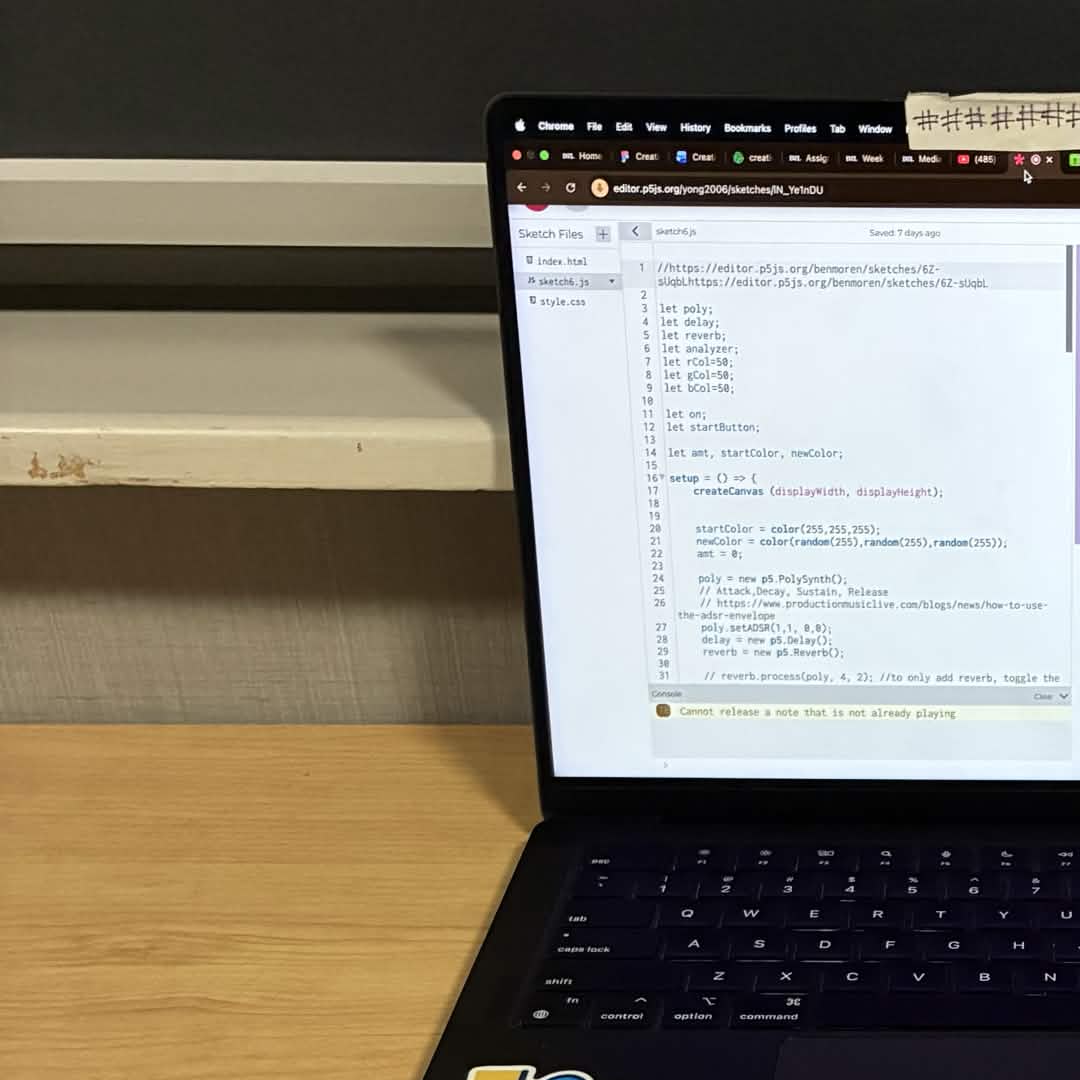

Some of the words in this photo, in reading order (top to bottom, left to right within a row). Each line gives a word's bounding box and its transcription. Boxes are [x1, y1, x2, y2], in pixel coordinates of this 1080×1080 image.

[538, 121, 574, 131] Chrome
[587, 122, 602, 131] File
[616, 122, 633, 131] Edit
[646, 123, 667, 131] View
[680, 123, 711, 134] History
[724, 123, 771, 133] Bookmarks
[785, 124, 817, 133] Profiles
[830, 124, 846, 133] Tab
[858, 124, 893, 133] Window
[975, 155, 996, 164] (485)
[518, 229, 555, 238] Sketch
[559, 229, 583, 239] Files
[904, 229, 926, 239] days
[538, 257, 587, 266] index.html
[539, 277, 589, 288] sketch6.js
[540, 297, 585, 307] style.css
[660, 304, 678, 313] let
[684, 304, 712, 315] poly;
[661, 317, 678, 326] let
[684, 317, 719, 329] delay;
[662, 330, 679, 340] let
[685, 330, 725, 342] reverb;
[662, 344, 680, 353] let
[686, 344, 738, 355] analyzer;
[664, 357, 680, 366] let
[687, 357, 733, 368] rCol=50;
[664, 370, 680, 379] let
[688, 370, 733, 381] gCol=50;
[665, 383, 682, 392] let
[688, 383, 734, 394] bCol=50;
[666, 409, 683, 418] let
[689, 411, 706, 420] on;
[667, 422, 684, 432] let
[690, 423, 759, 432] startButton;
[668, 448, 686, 457] let
[692, 449, 713, 459] amt,
[721, 448, 784, 459] startColor,
[791, 448, 842, 459] newColor;
[670, 475, 699, 485] setup
[694, 487, 764, 495] createCanvas
[696, 524, 754, 533] startColor
[696, 537, 742, 546] newColor
[699, 573, 721, 587] poly
[797, 587, 842, 598] Sustain,
[848, 587, 888, 596] Release
[678, 611, 775, 623] the-adsr-envelope
[702, 635, 731, 646] delay
[704, 648, 737, 656] reverb
[908, 672, 930, 683] only
[936, 673, 953, 682] add
[959, 673, 996, 683] reverb,
[1004, 673, 1037, 684] toggle
[1043, 674, 1060, 682] the
[651, 690, 682, 698] Console
[680, 707, 713, 716] Cannot
[720, 707, 759, 716] release
[776, 709, 799, 717] note
[804, 708, 827, 717] that
[833, 709, 844, 717] is
[872, 708, 911, 720] already
[916, 709, 956, 719] playing
[681, 909, 693, 917] Q
[810, 910, 819, 918] E
[873, 910, 883, 918] R
[688, 939, 699, 947] A
[754, 940, 765, 948] S
[819, 940, 831, 948] D
[948, 941, 960, 949] G
[713, 972, 725, 980] Z
[780, 972, 792, 980] X
[847, 972, 858, 981] C
[913, 973, 925, 981] V
[980, 973, 990, 981] B
[1045, 973, 1056, 981] N
